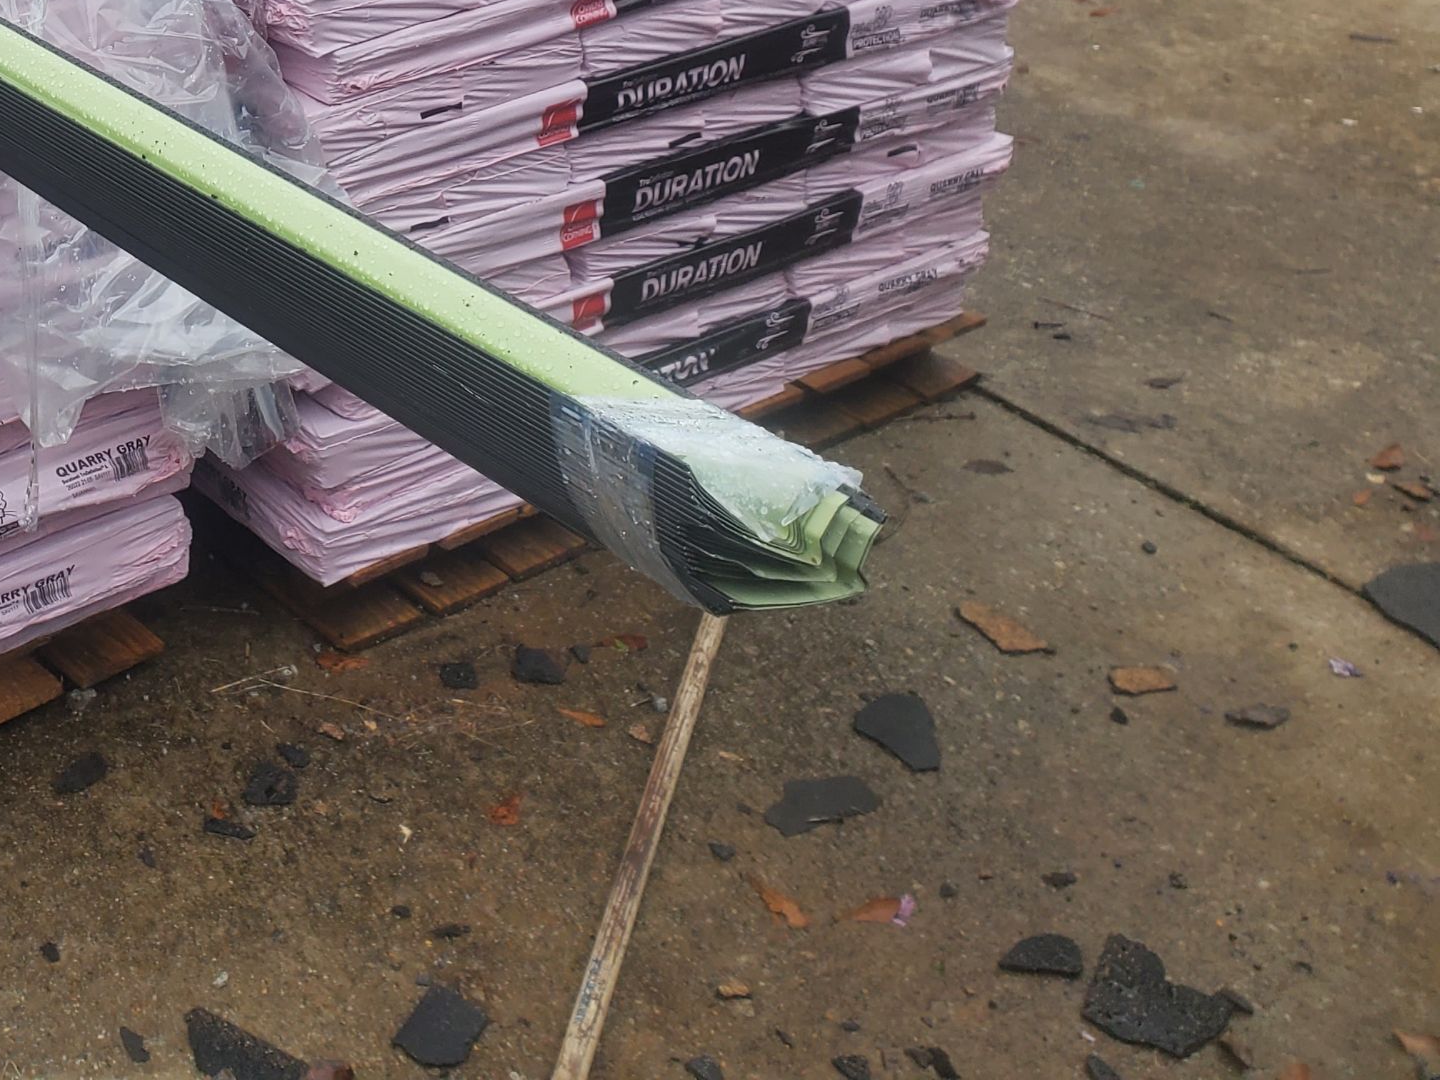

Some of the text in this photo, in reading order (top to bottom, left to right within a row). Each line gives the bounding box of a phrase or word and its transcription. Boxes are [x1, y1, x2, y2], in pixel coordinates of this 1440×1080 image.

[853, 29, 900, 50] PROTECTION
[618, 54, 745, 110] DURATION
[632, 150, 760, 214] DURATION
[641, 241, 762, 303] DURATION
[56, 435, 151, 478] QUARRY GRAY
[35, 564, 75, 588] GRAY
